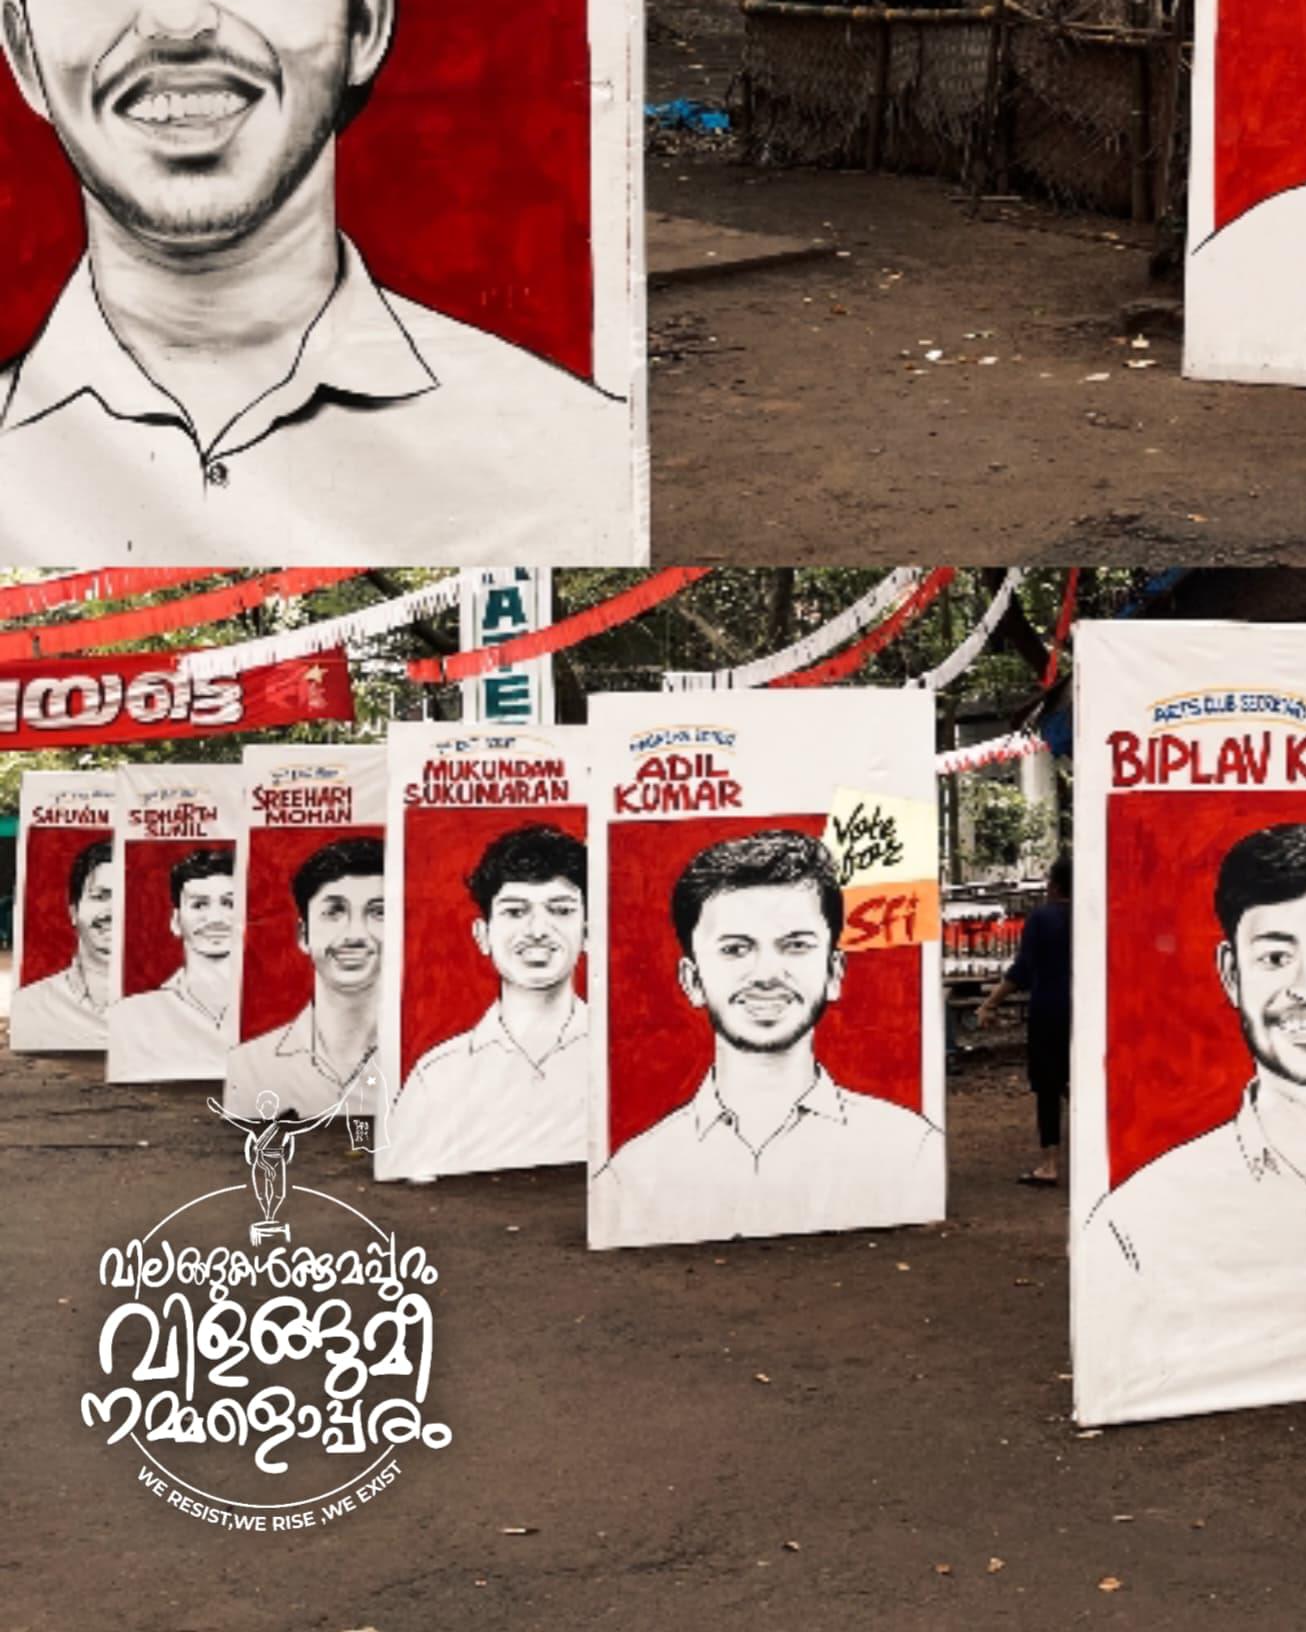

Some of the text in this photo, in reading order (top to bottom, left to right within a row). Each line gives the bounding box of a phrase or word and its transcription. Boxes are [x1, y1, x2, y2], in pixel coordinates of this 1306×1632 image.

[422, 759, 565, 783] MUKUNDAN
[636, 753, 730, 784] ADIL
[1106, 731, 1271, 788] BIPLAV
[251, 784, 353, 811] SREEHARI
[403, 780, 570, 806] SUKUMARAN
[613, 780, 743, 814] KUMAR
[265, 807, 352, 826] MOHAN
[833, 803, 897, 847] Vote
